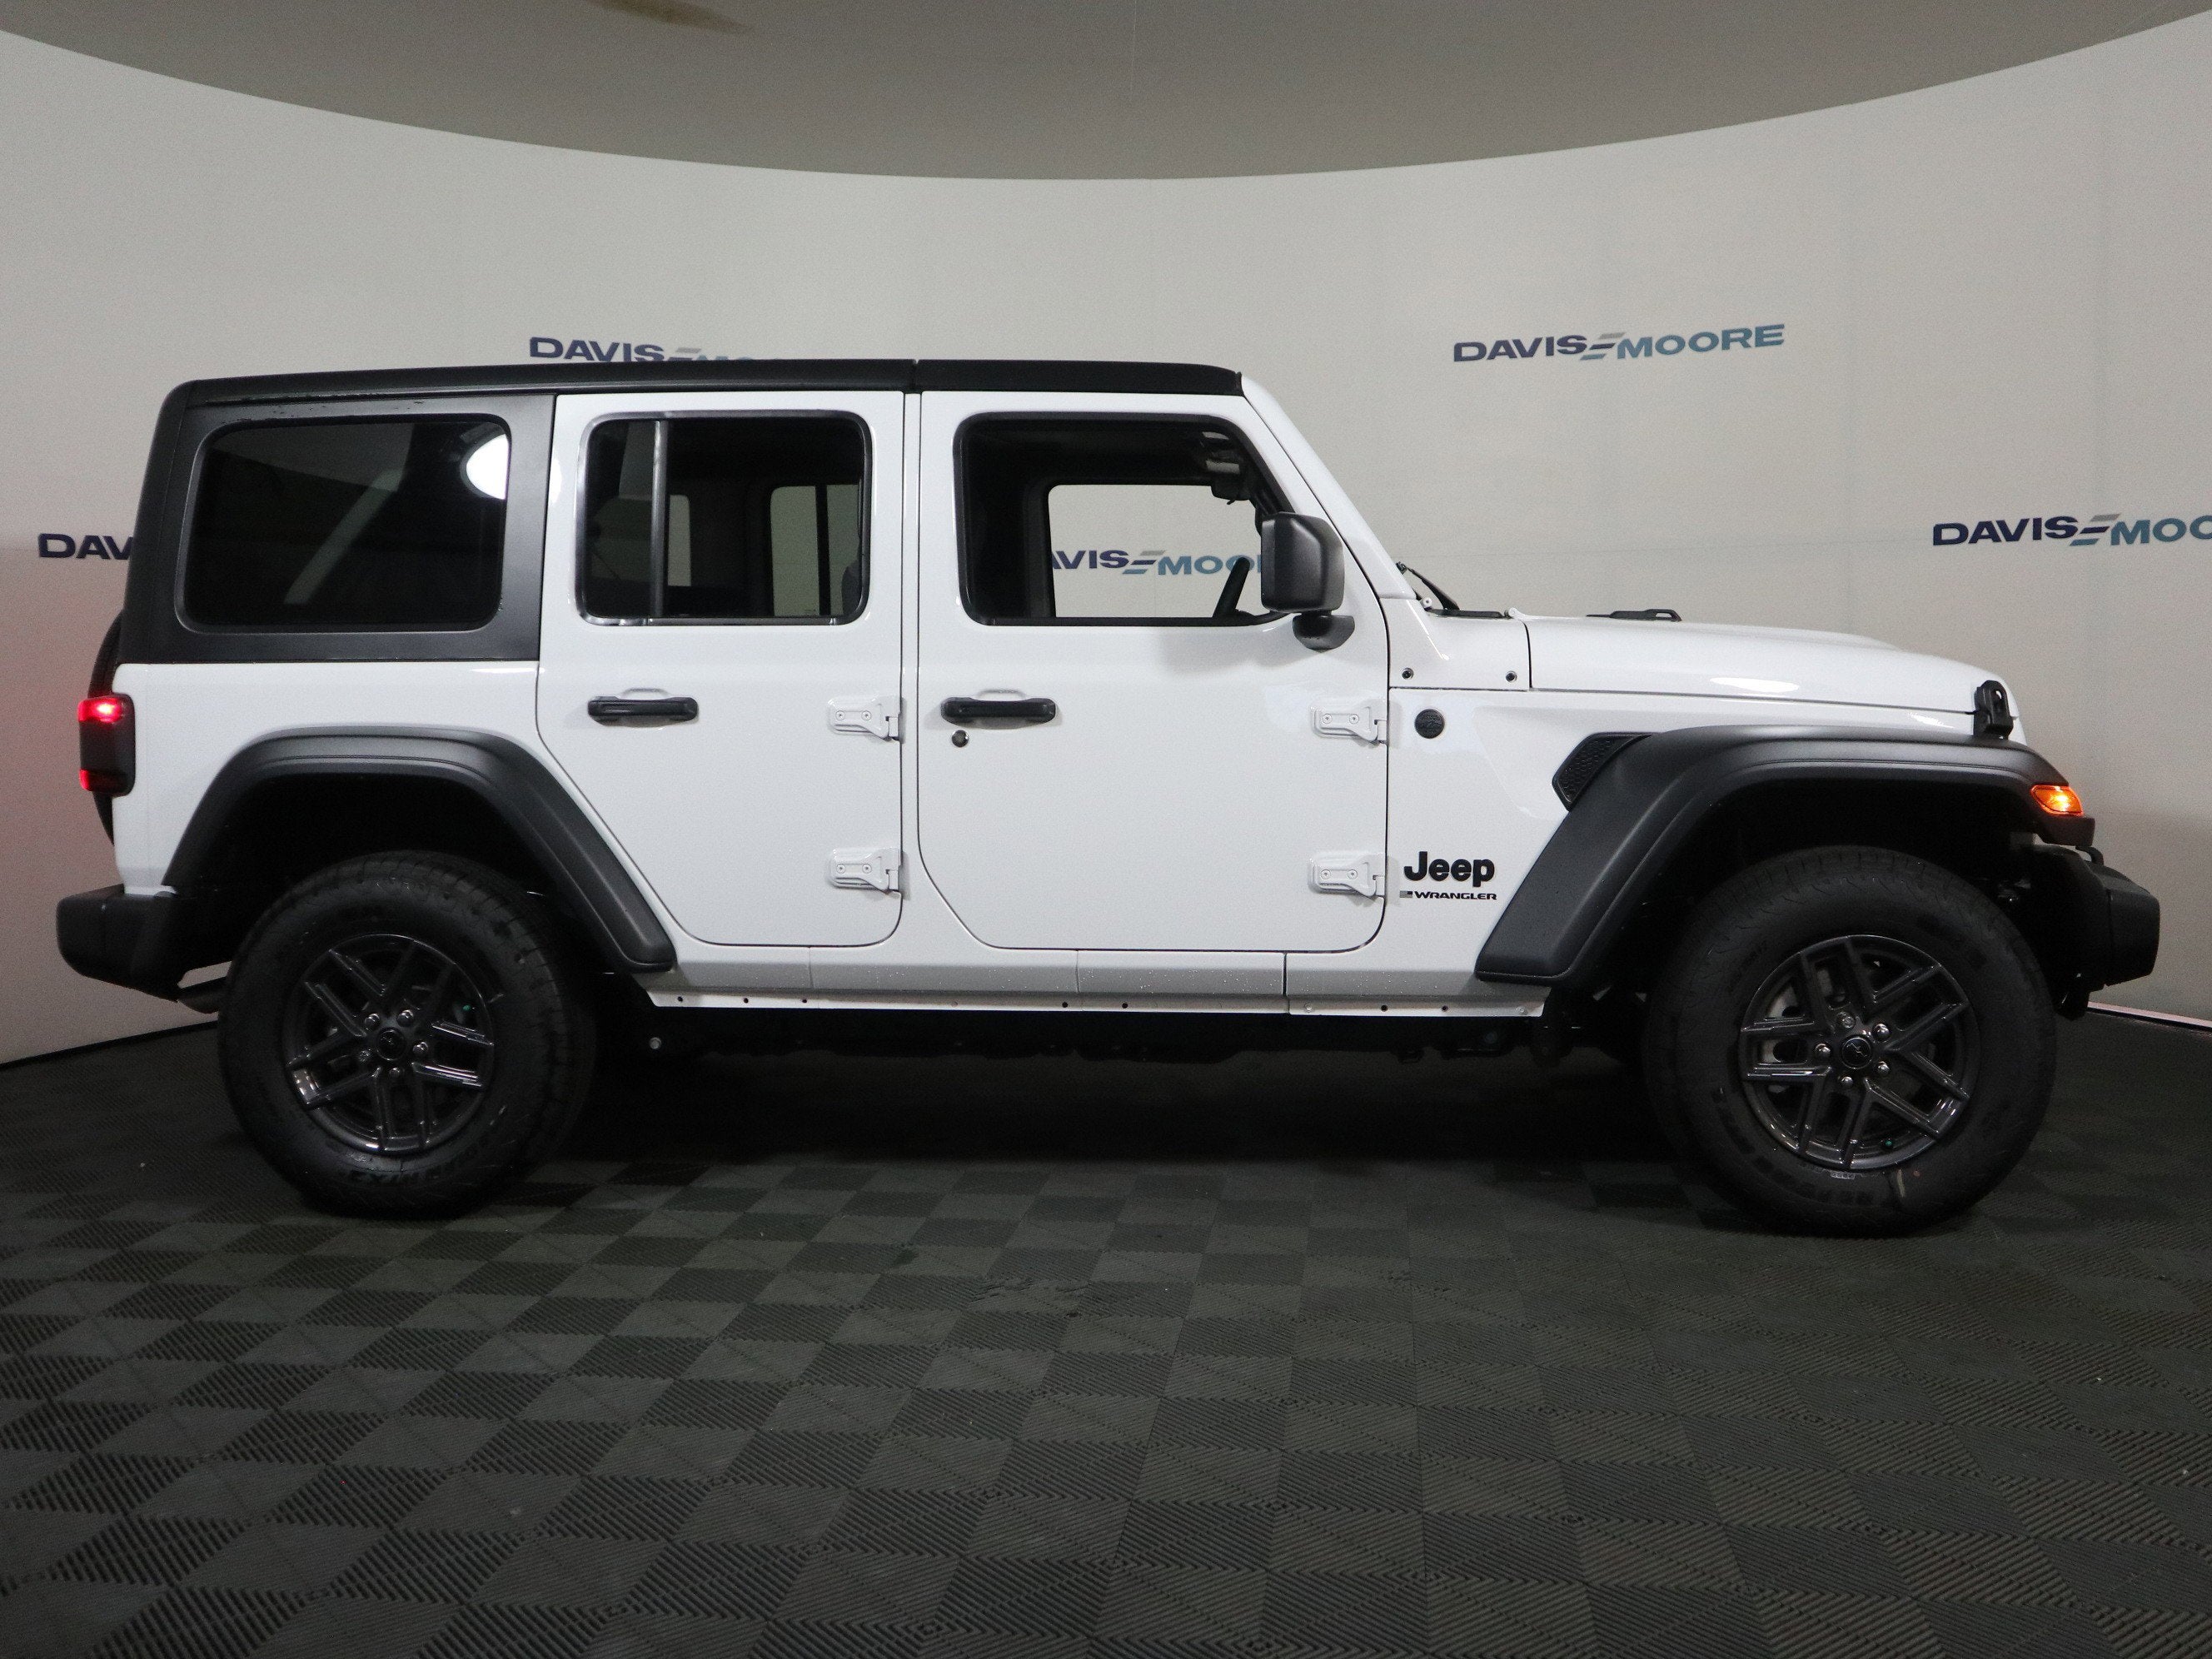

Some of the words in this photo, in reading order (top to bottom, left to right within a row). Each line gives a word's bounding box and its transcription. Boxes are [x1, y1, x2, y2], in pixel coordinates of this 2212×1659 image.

[530, 336, 665, 361] DAVIS
[1454, 335, 1588, 362] DAVIS
[1617, 324, 1785, 359] MOORE
[1933, 516, 2079, 546] DAVIS
[2110, 515, 2212, 546] MOO
[37, 533, 133, 560] DAV
[1403, 851, 1495, 888] Jeep
[1414, 891, 1497, 900] WRANGLER
